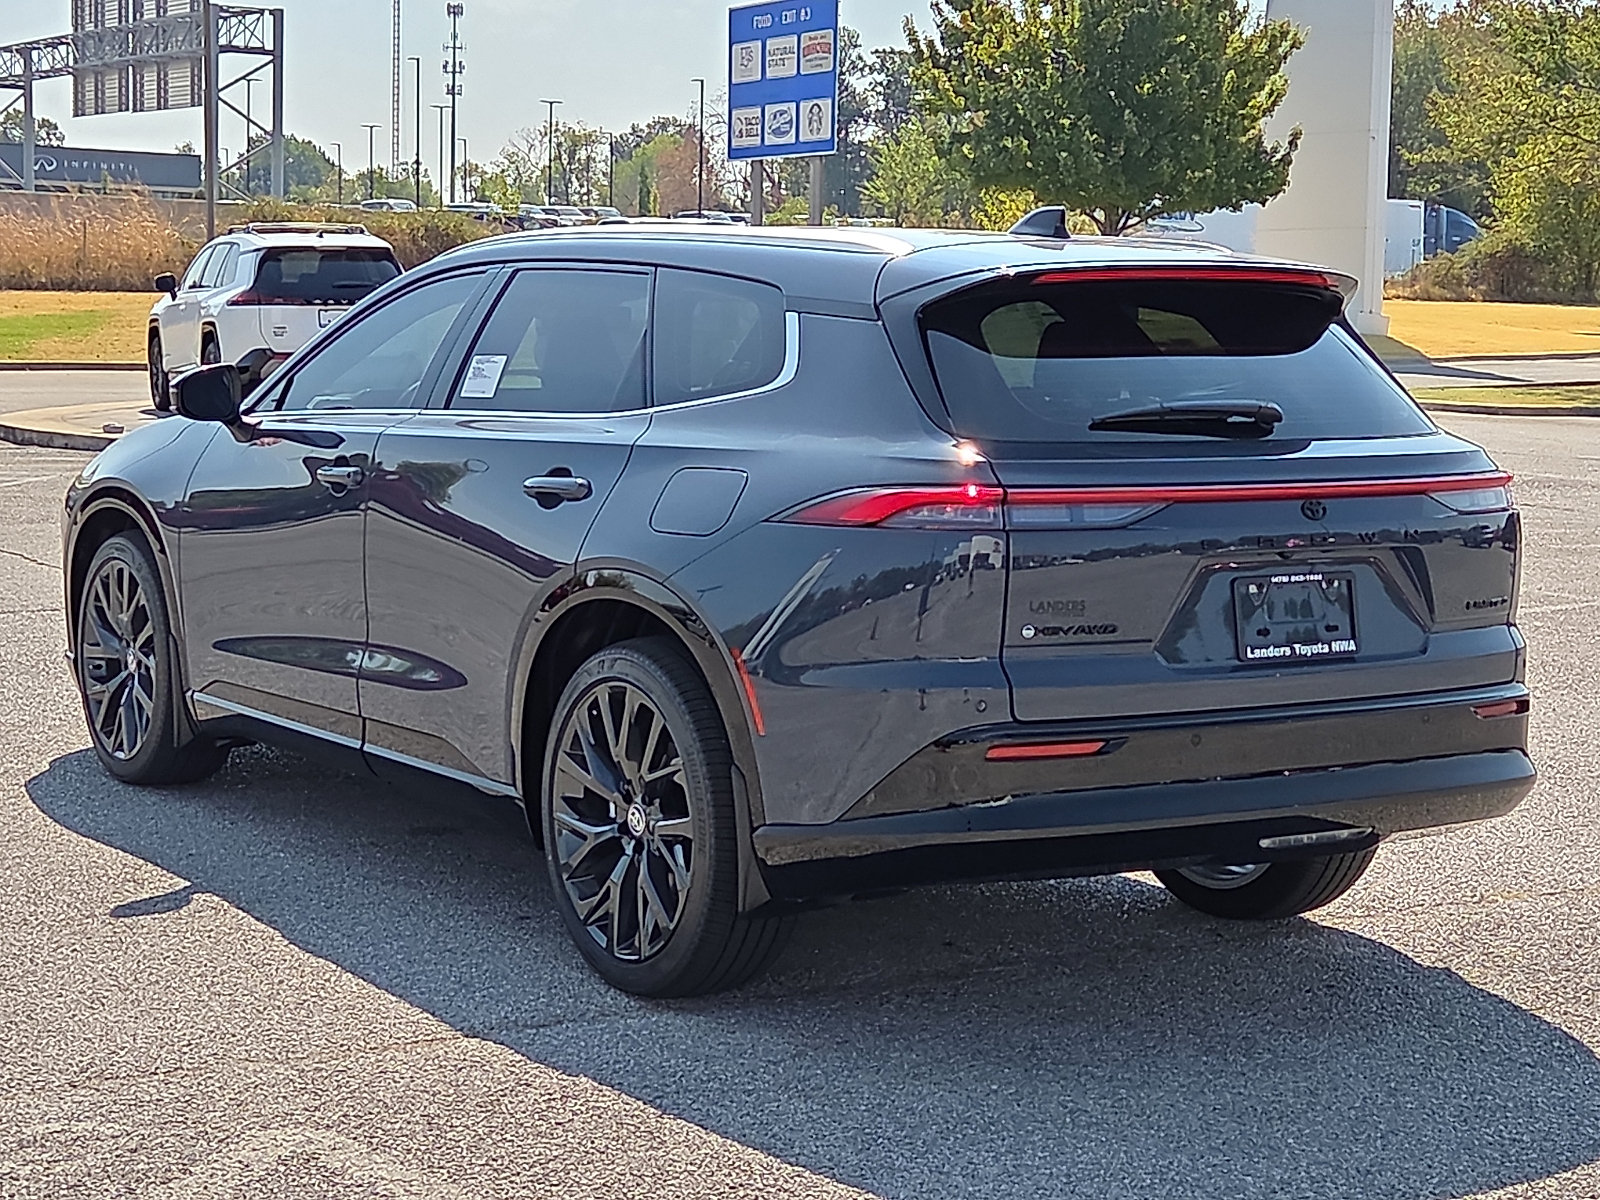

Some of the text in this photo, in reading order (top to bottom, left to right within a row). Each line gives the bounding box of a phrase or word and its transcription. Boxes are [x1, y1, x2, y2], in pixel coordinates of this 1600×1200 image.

[768, 46, 796, 57] NATURAL
[768, 58, 786, 68] STATE
[744, 115, 760, 126] TACO
[744, 127, 760, 138] BELL
[63, 159, 133, 171] INFINITI
[1029, 600, 1086, 613] LANDERS
[1247, 640, 1357, 659] Landers Toyota NWA
